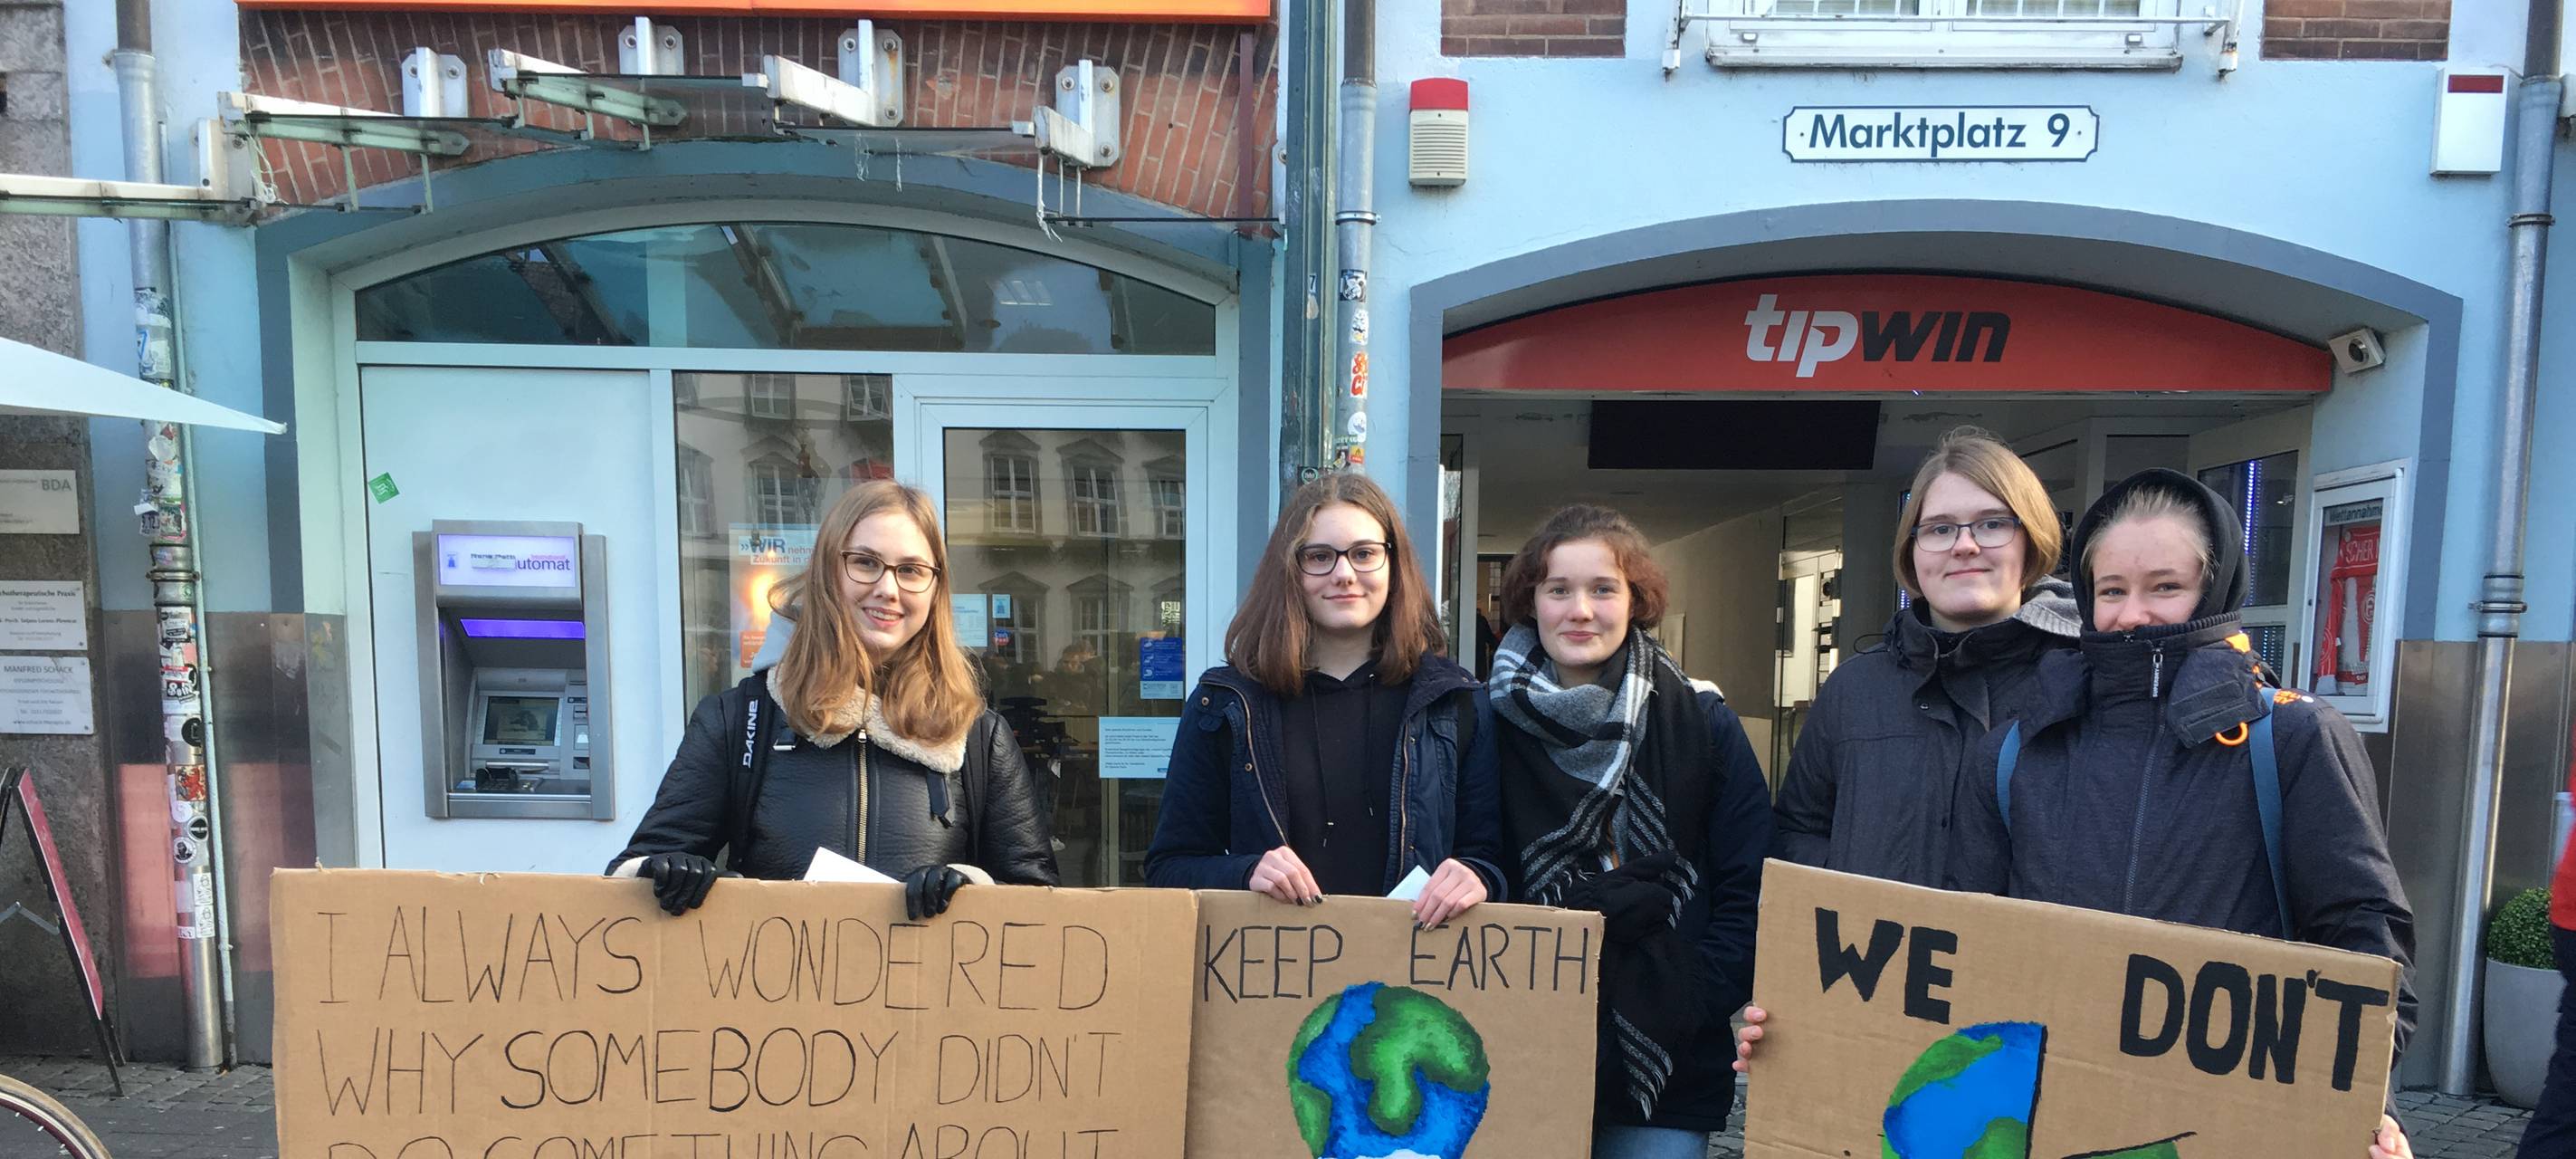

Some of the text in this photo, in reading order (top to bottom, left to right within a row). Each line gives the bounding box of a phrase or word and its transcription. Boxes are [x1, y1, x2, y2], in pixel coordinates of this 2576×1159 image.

[1809, 111, 2071, 158] Marktplatz 9
[1743, 293, 2012, 378] tipwin
[41, 478, 72, 491] BDA
[517, 557, 571, 570] utomat
[787, 545, 814, 554] nehm
[57, 589, 76, 598] Praxis
[4, 665, 43, 674] MANFRED
[742, 699, 758, 769] DAKINE
[317, 905, 1108, 1011] I ALWAYS WONDERED
[1203, 923, 1589, 1004] KEEP EARTH
[1814, 906, 2390, 1092] WE DON'T
[317, 1027, 1122, 1116] WHY SOMEBODY DIDN'T
